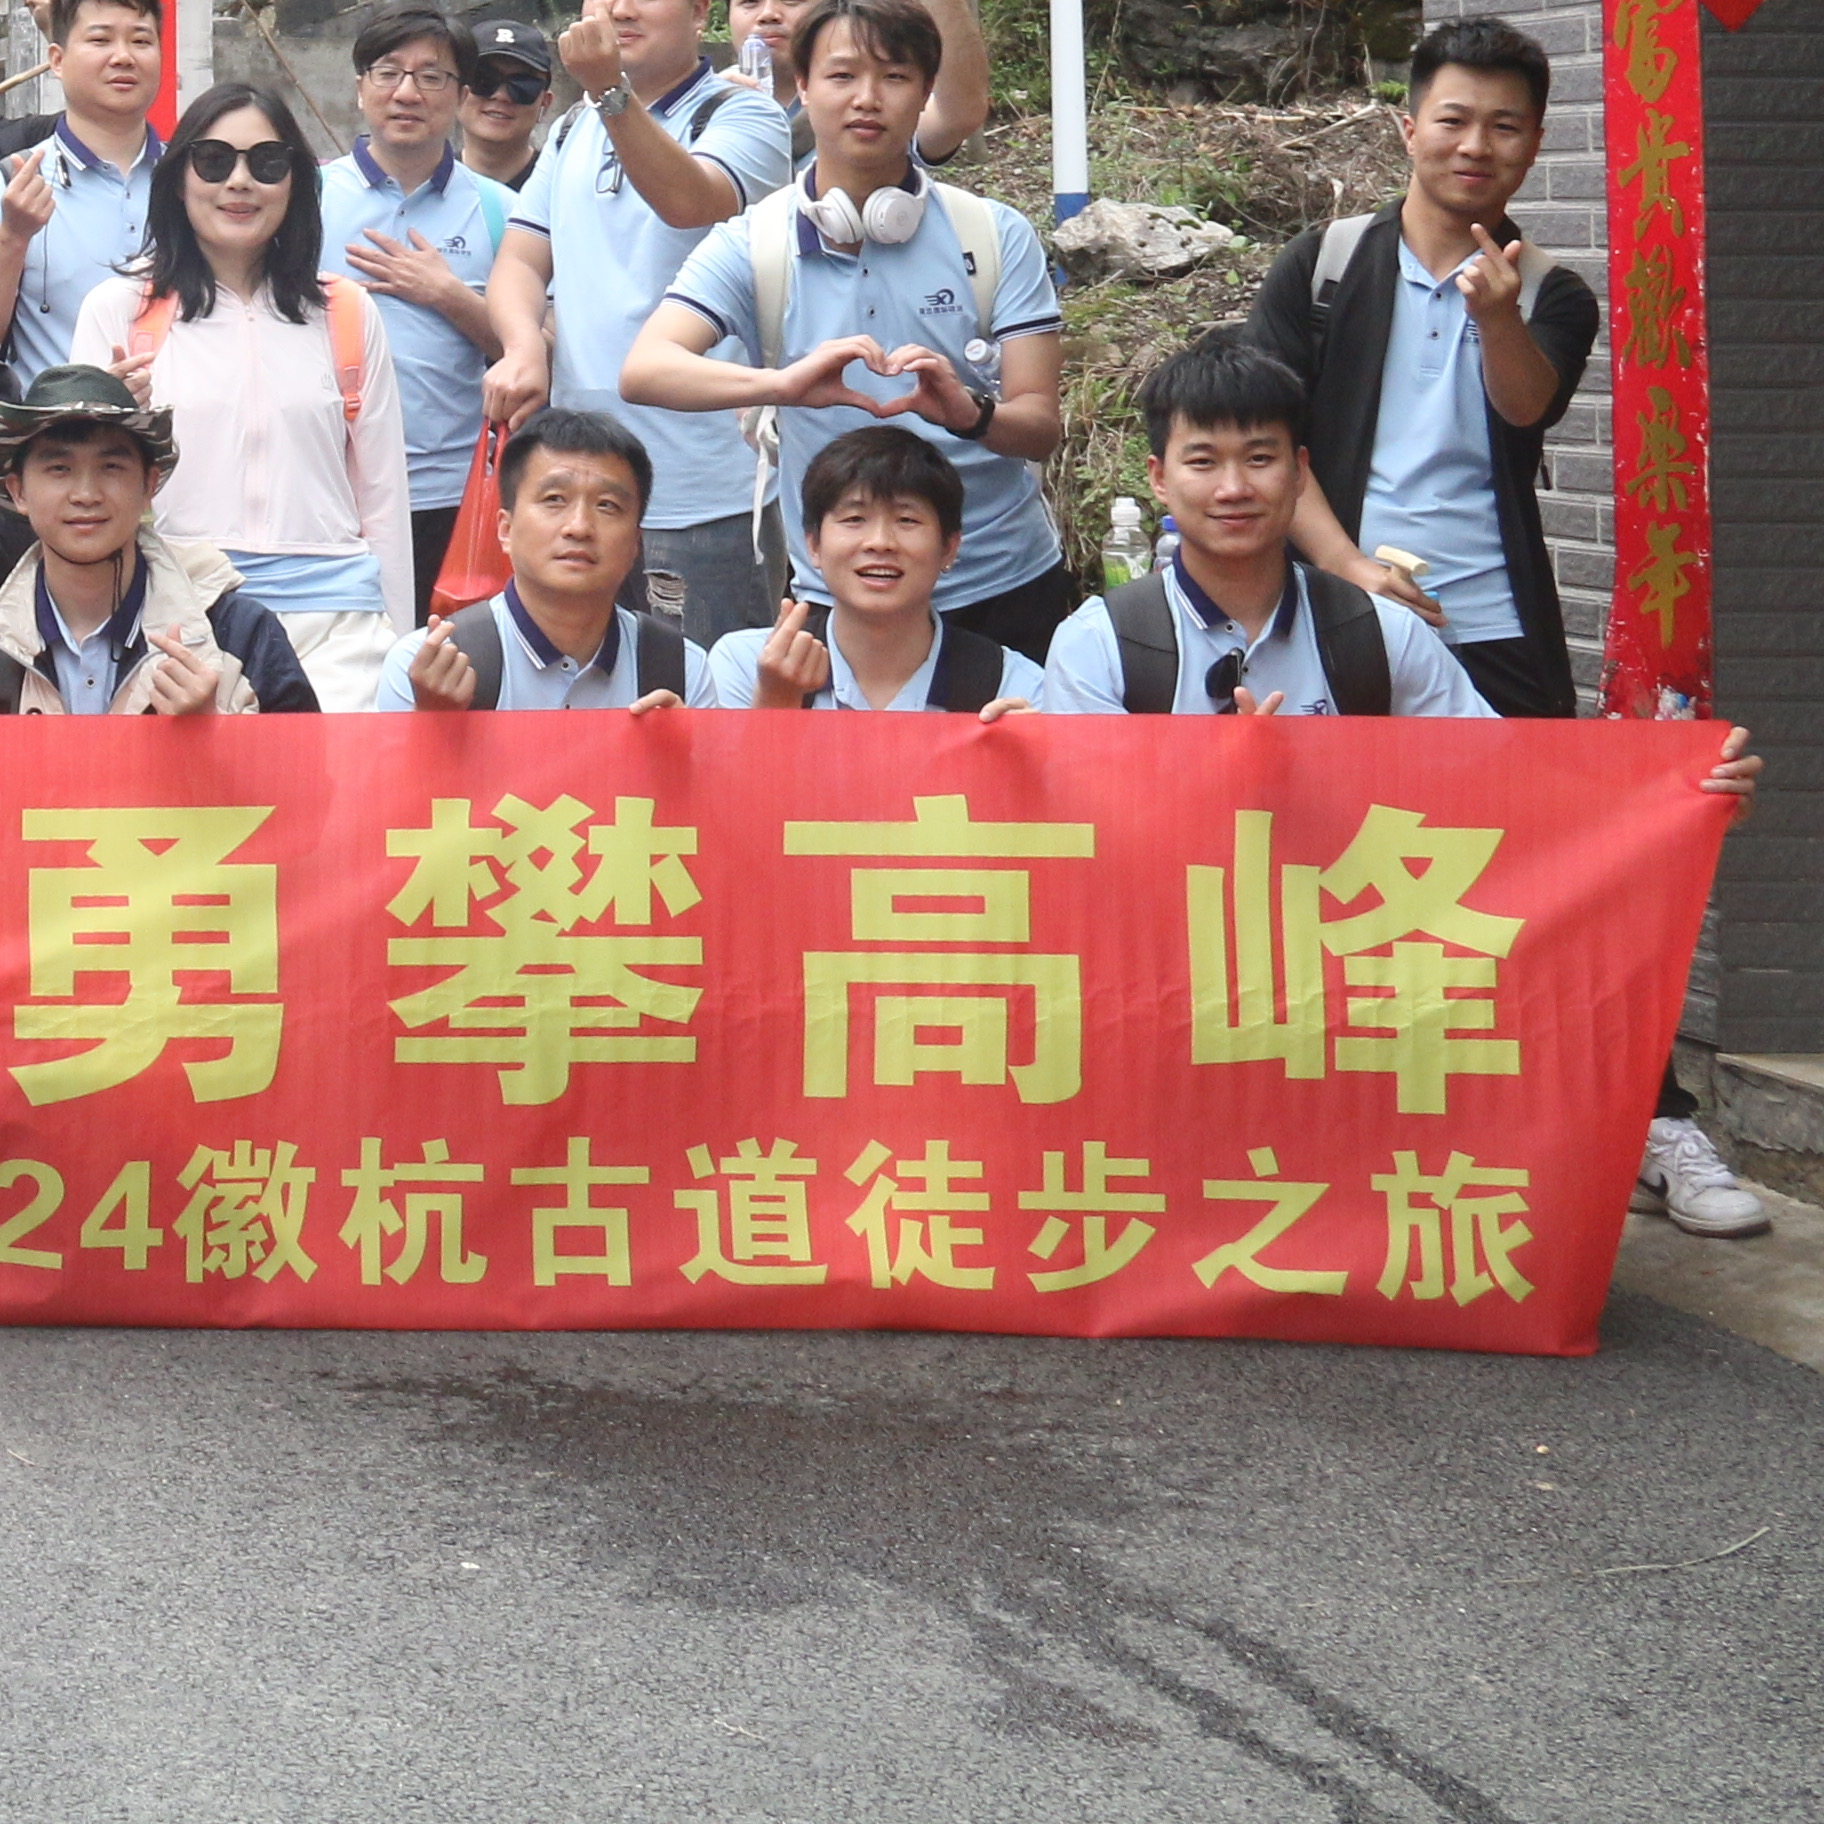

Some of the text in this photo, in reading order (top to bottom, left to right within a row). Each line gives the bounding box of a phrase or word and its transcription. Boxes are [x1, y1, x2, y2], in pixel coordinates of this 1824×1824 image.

[495, 28, 515, 43] R
[7, 793, 1528, 1116] 勇攀高峰
